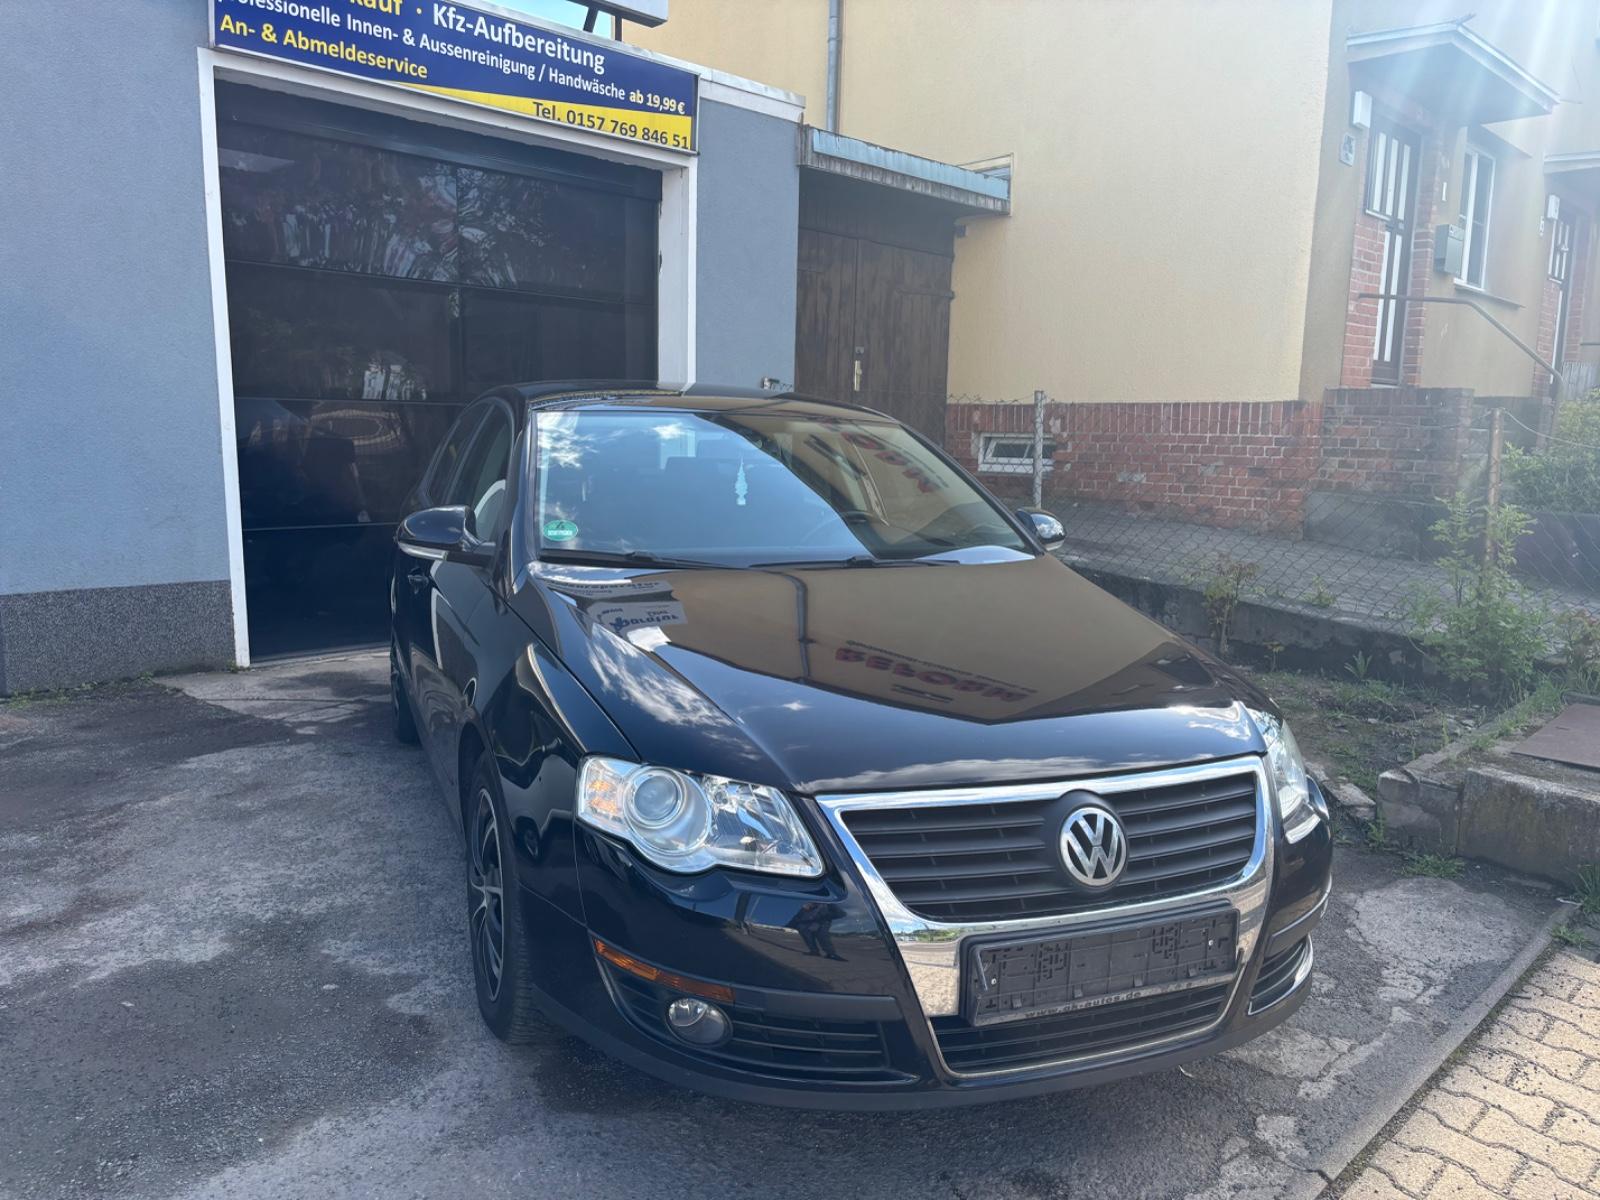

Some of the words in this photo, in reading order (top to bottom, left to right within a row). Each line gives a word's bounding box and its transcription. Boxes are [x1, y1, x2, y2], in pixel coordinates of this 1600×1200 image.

[218, 0, 341, 27] essionelle
[346, 13, 398, 40] Innen-
[402, 28, 416, 47] &
[419, 33, 536, 81] Aussenreinigung
[538, 64, 546, 82] /
[549, 67, 626, 100] Handwäsche
[629, 91, 644, 105] ab
[220, 14, 256, 36] An-
[261, 23, 278, 44] &
[282, 29, 428, 78] Abmeldeservice
[350, 0, 403, 16] auf
[433, 3, 605, 75] Kfz-Aufbereitung
[532, 101, 561, 122] Tel.
[566, 109, 606, 131] 0157
[610, 119, 638, 139] 769
[641, 127, 669, 146] 846
[672, 134, 689, 150] 51
